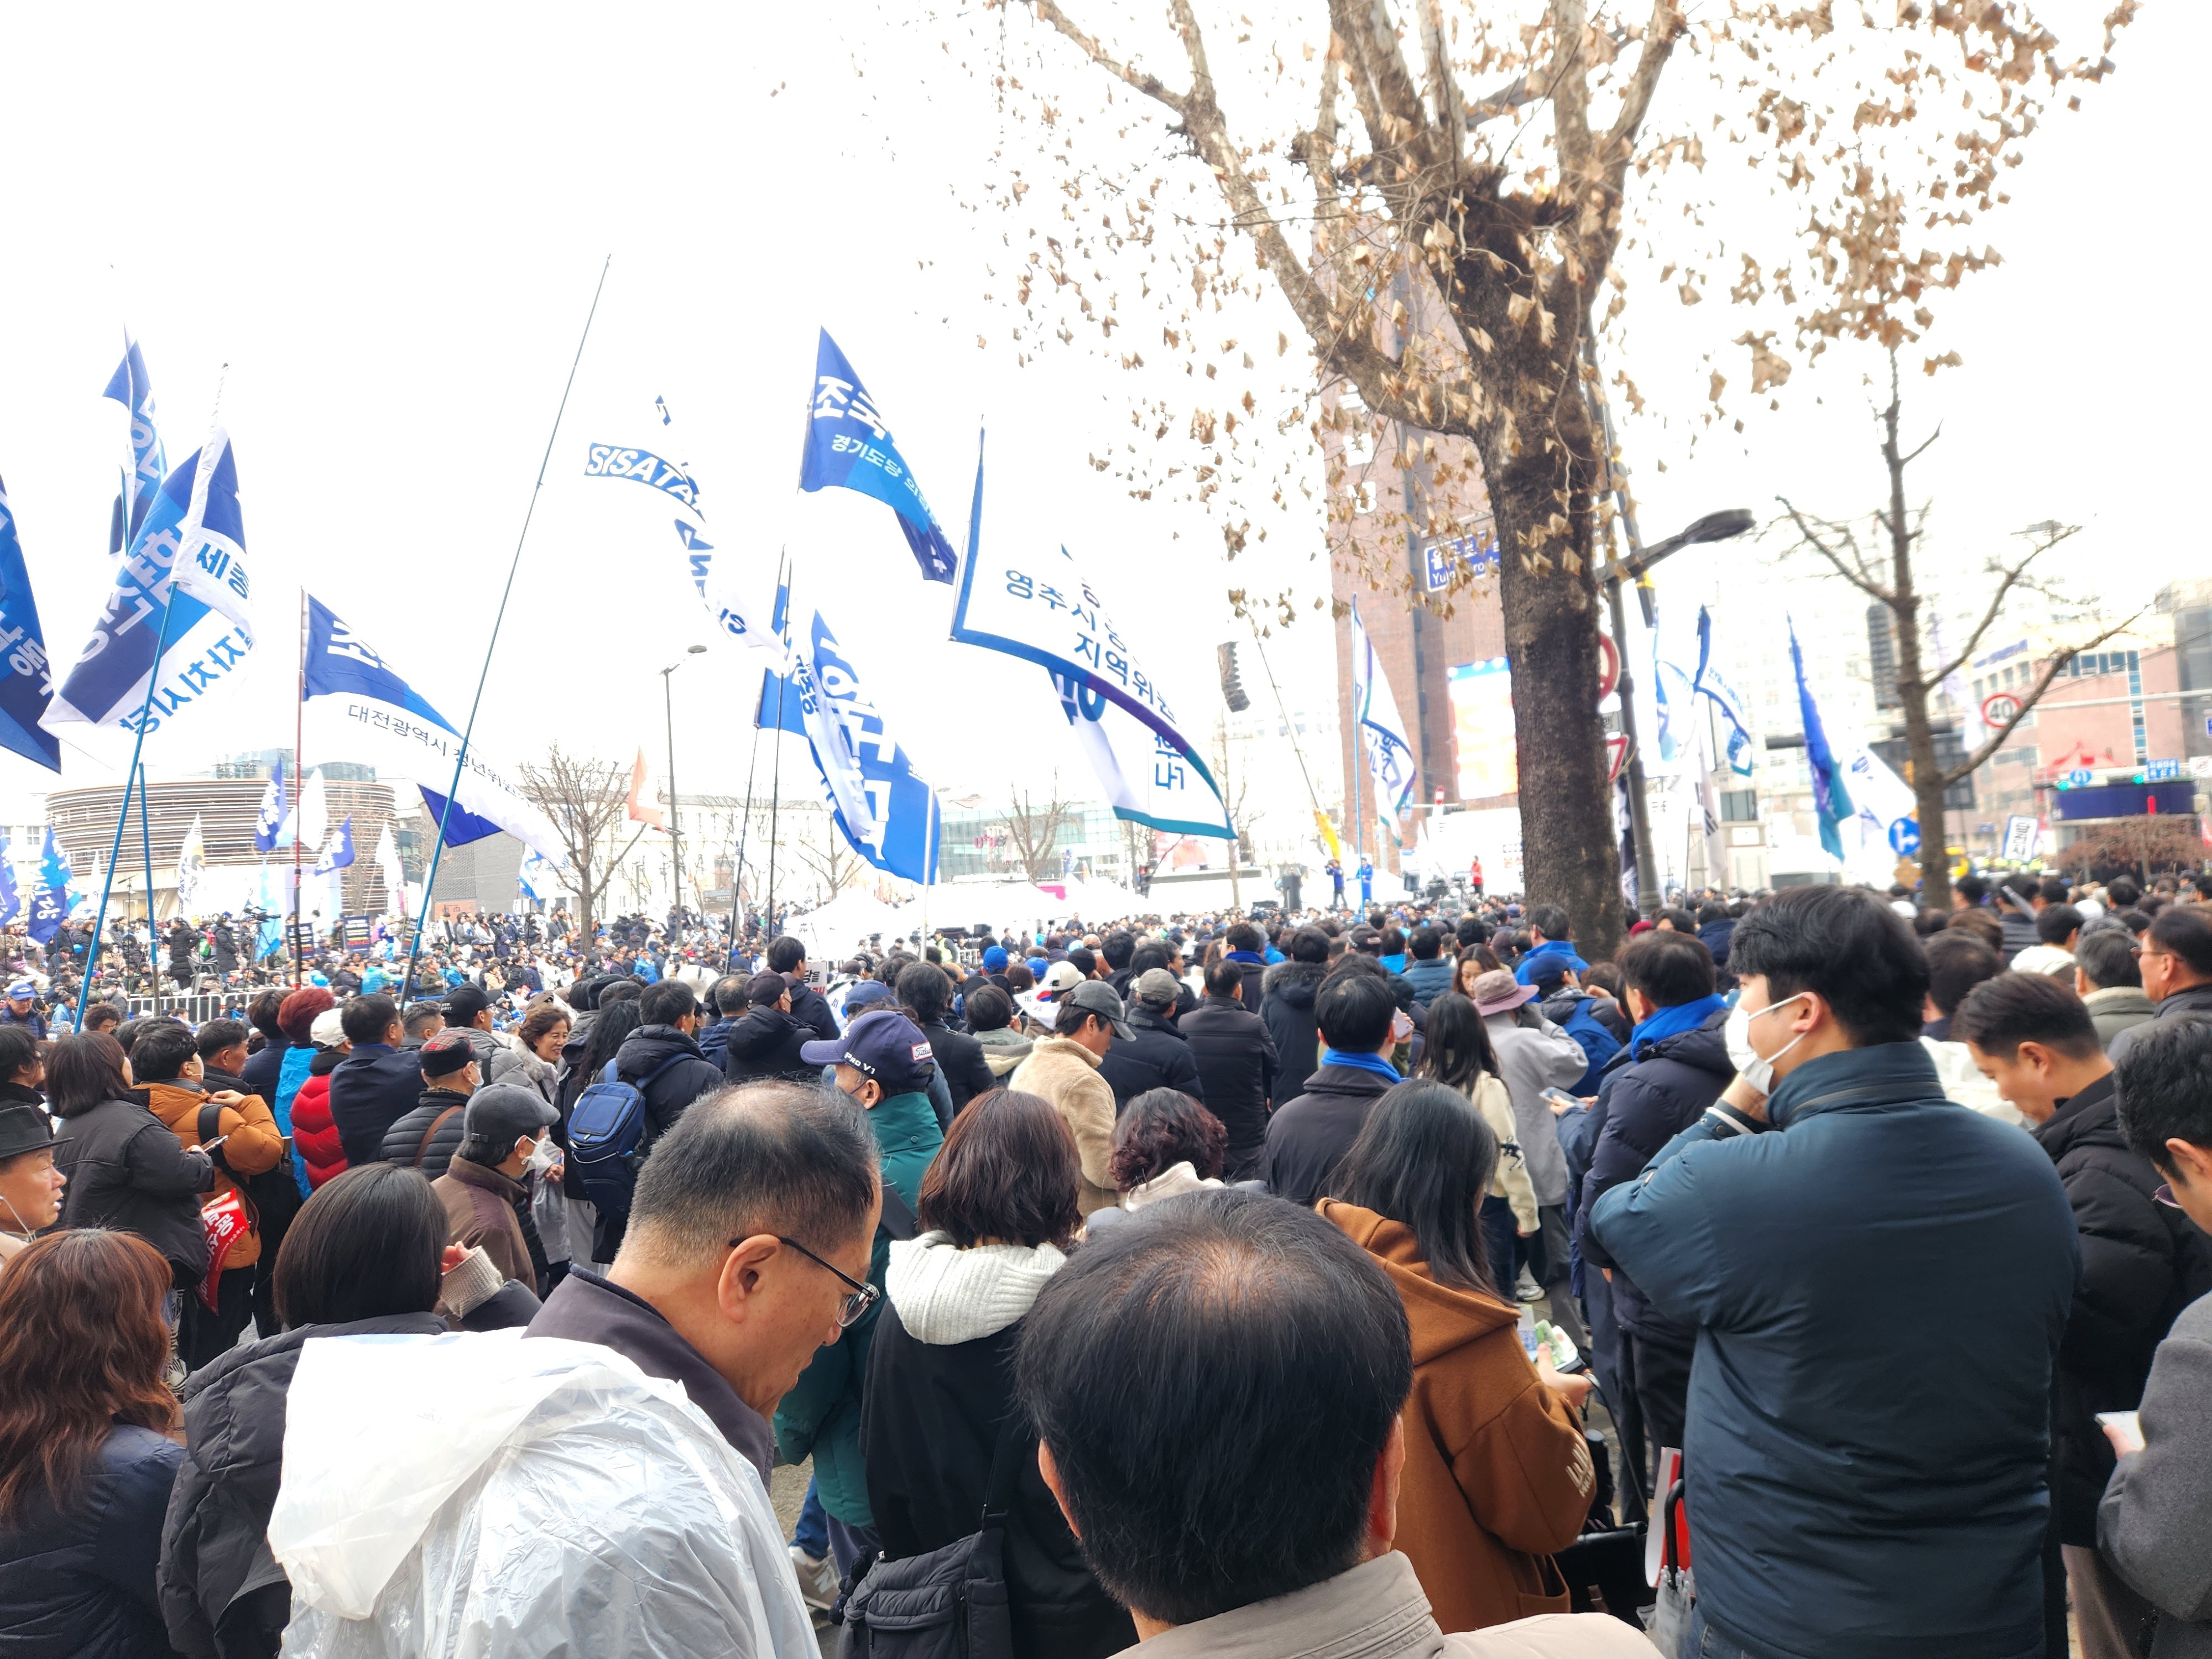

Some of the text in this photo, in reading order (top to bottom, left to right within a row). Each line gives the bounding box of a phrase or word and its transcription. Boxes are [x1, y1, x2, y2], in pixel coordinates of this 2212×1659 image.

[831, 434, 902, 477] 경기도당
[1989, 700, 2013, 719] 40
[348, 704, 447, 757] 대전광역시
[863, 1063, 875, 1075] V1
